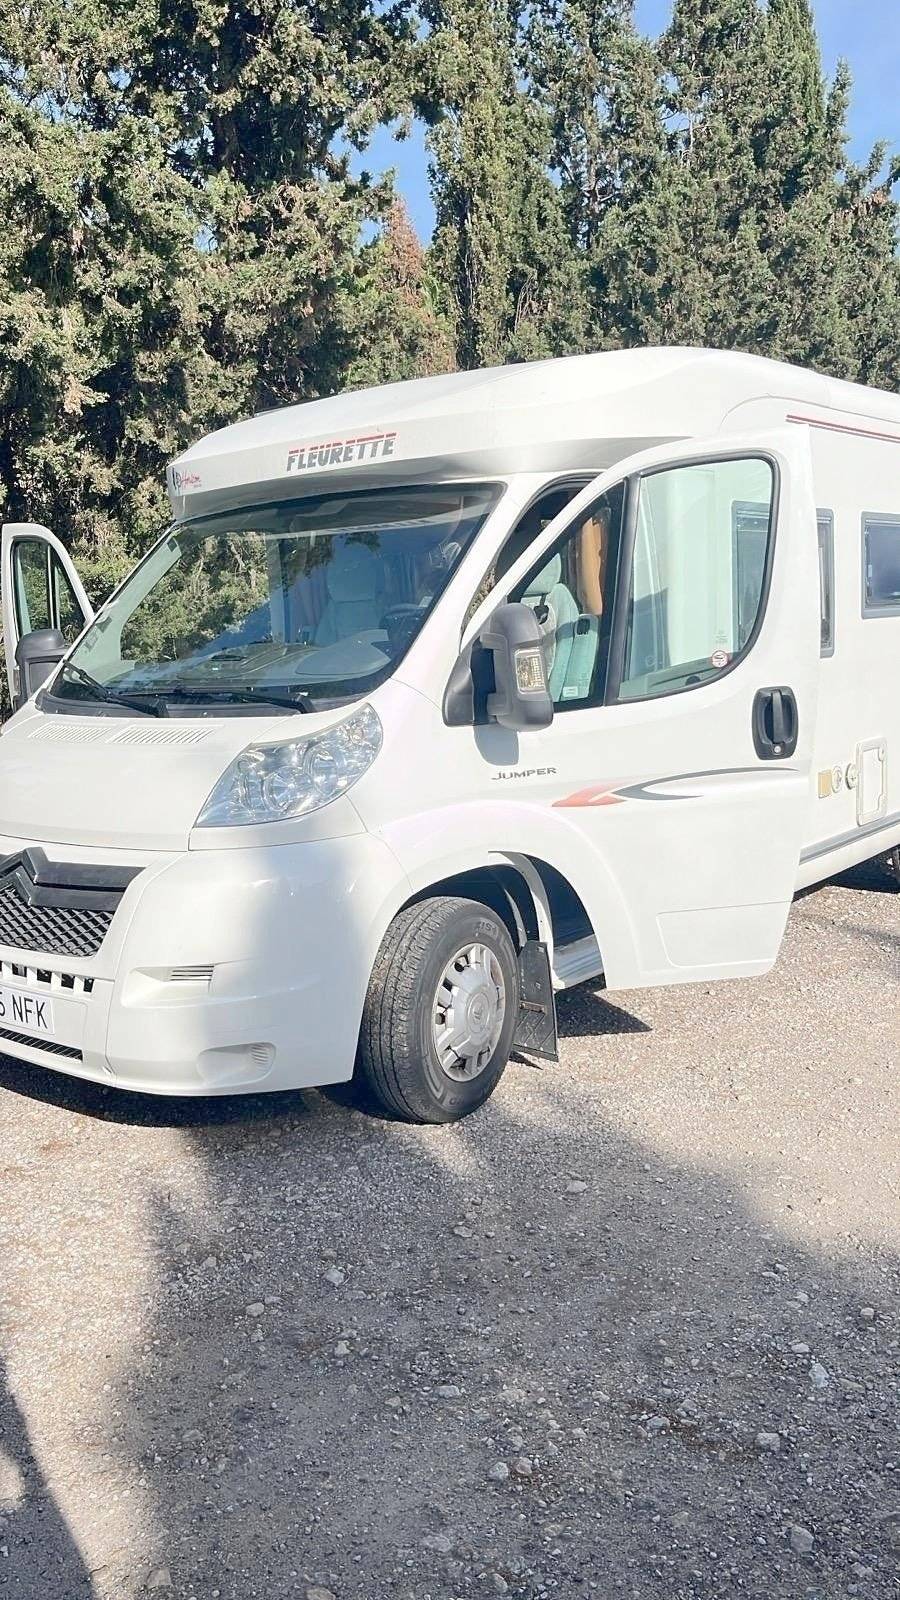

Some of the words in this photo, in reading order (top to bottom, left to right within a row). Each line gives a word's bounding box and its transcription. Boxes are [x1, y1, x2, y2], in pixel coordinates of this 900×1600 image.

[286, 432, 397, 471] FLEURETTE
[491, 767, 557, 780] JUMPER
[12, 994, 48, 1029] NFK
